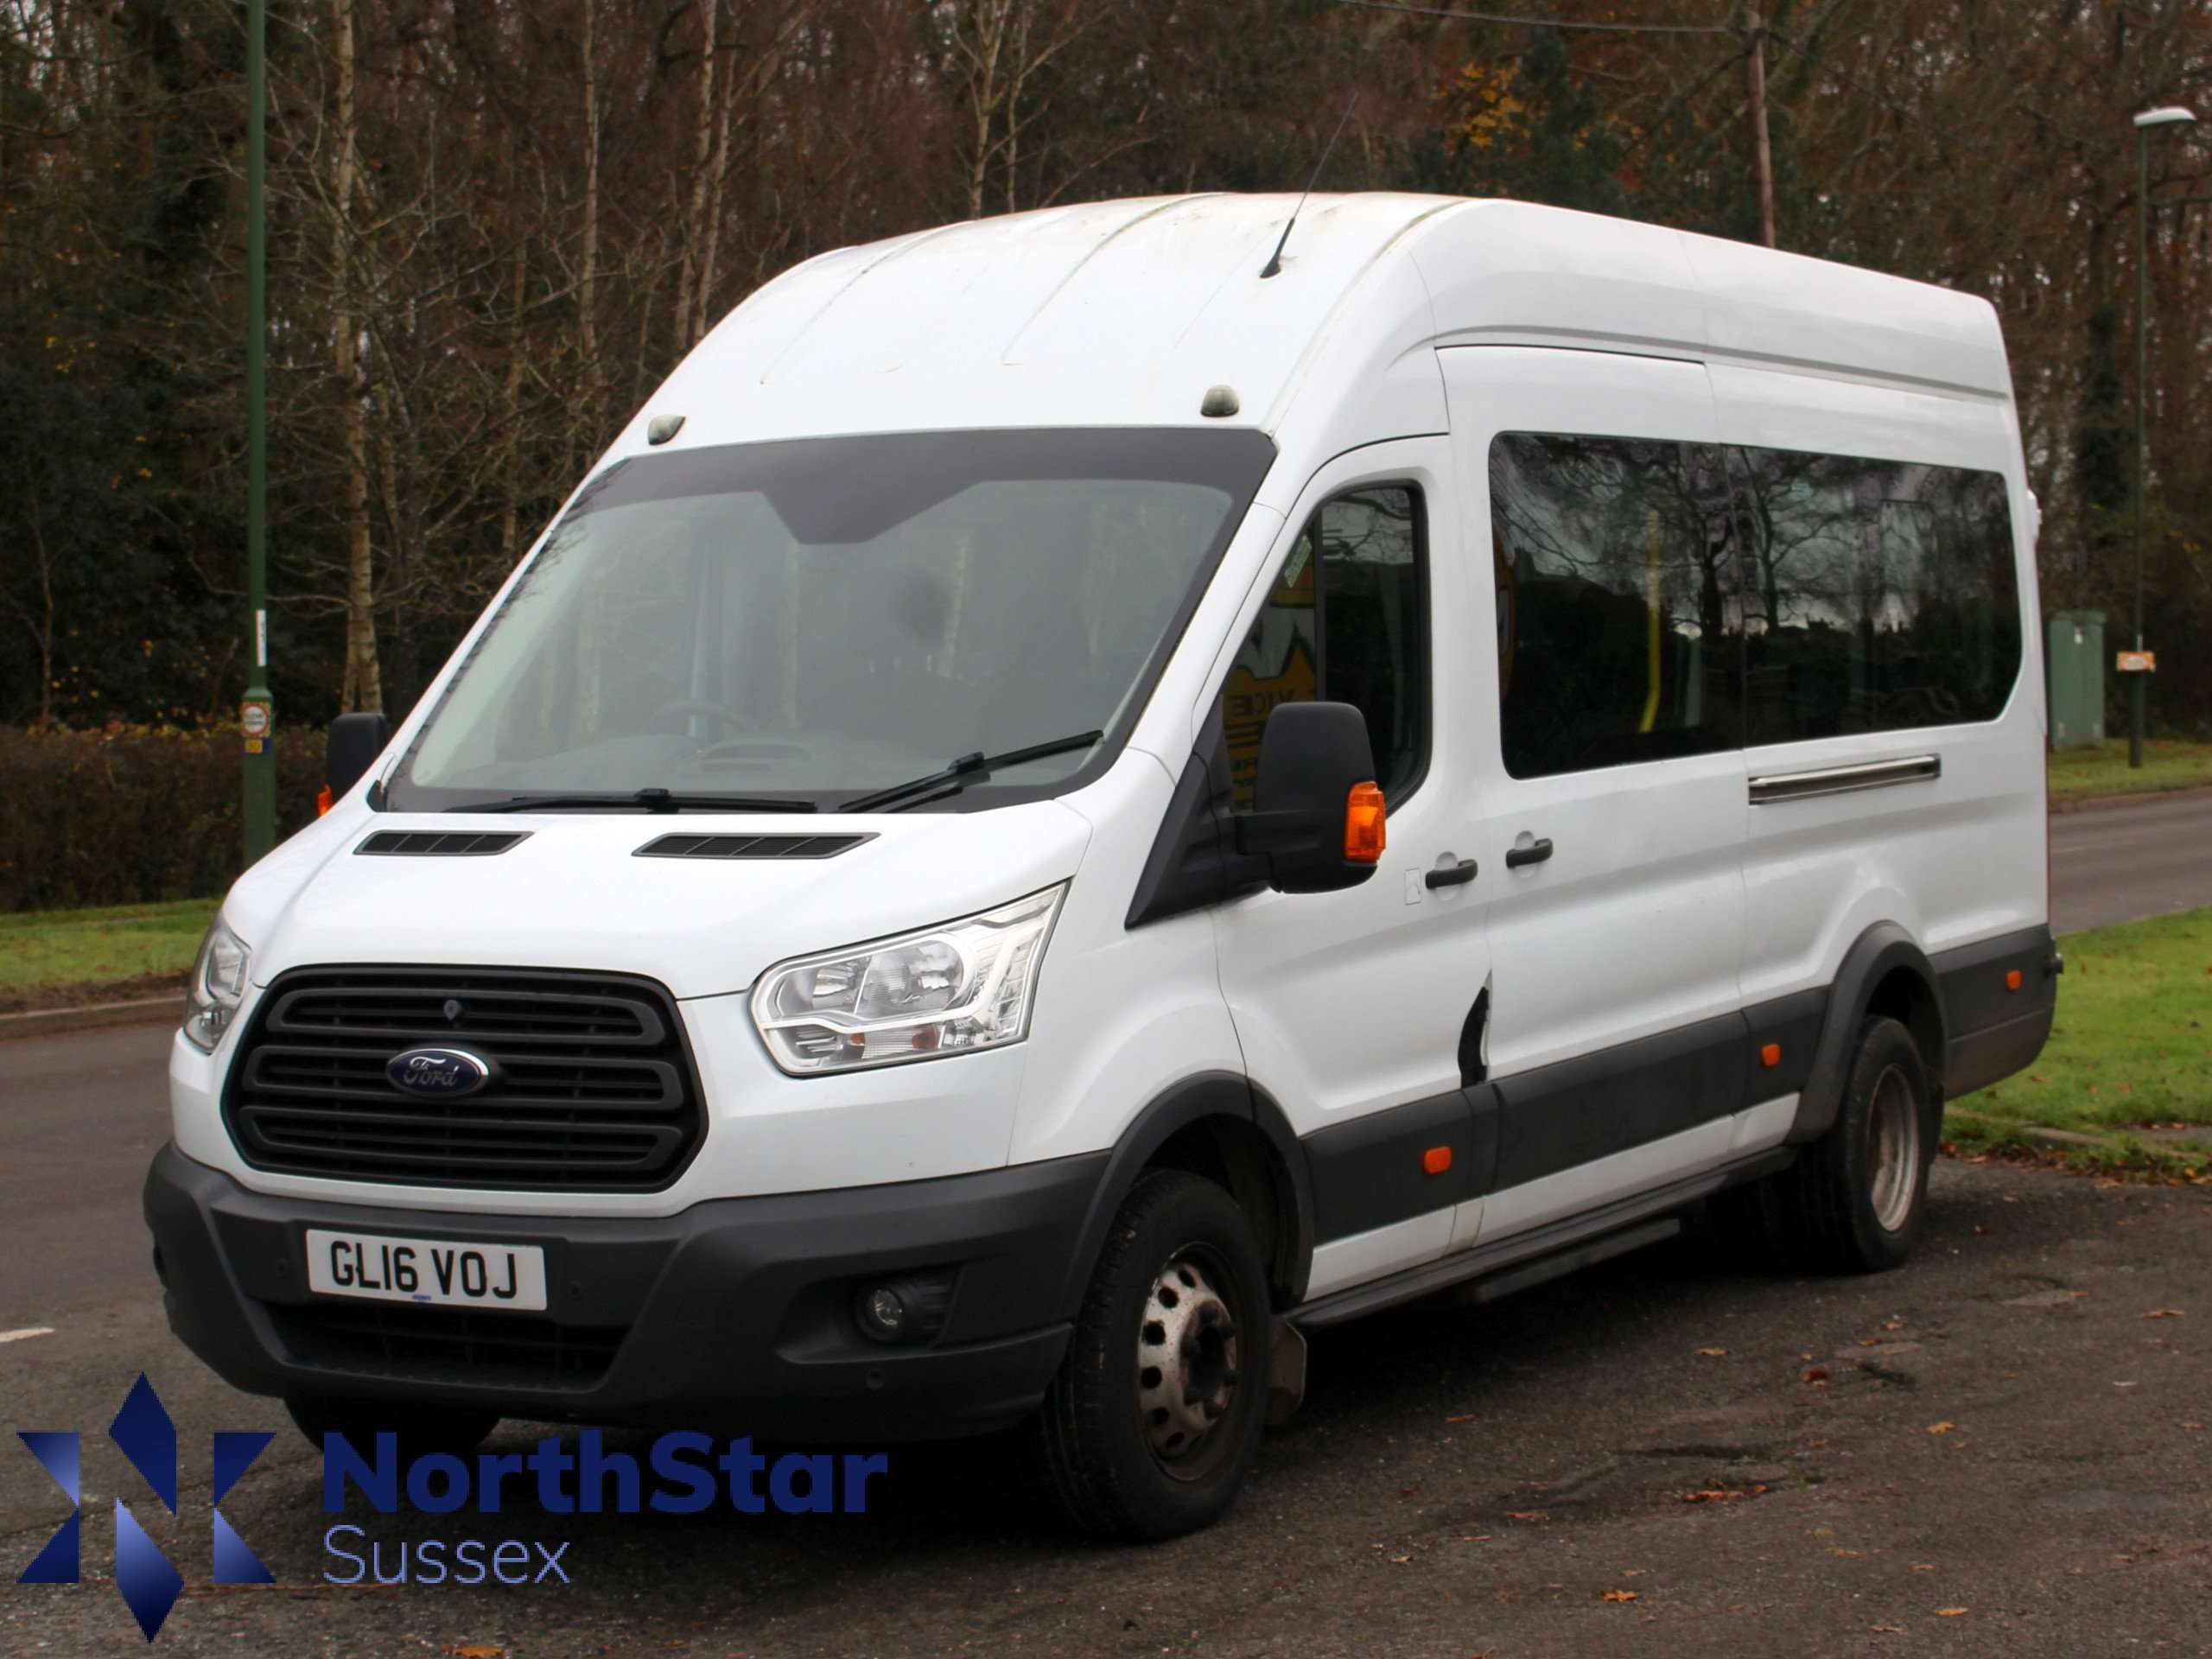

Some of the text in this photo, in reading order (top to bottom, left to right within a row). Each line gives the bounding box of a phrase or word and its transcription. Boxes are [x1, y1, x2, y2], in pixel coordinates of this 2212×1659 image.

[403, 1056, 460, 1086] Ford
[330, 1241, 518, 1300] GL16 VOJ
